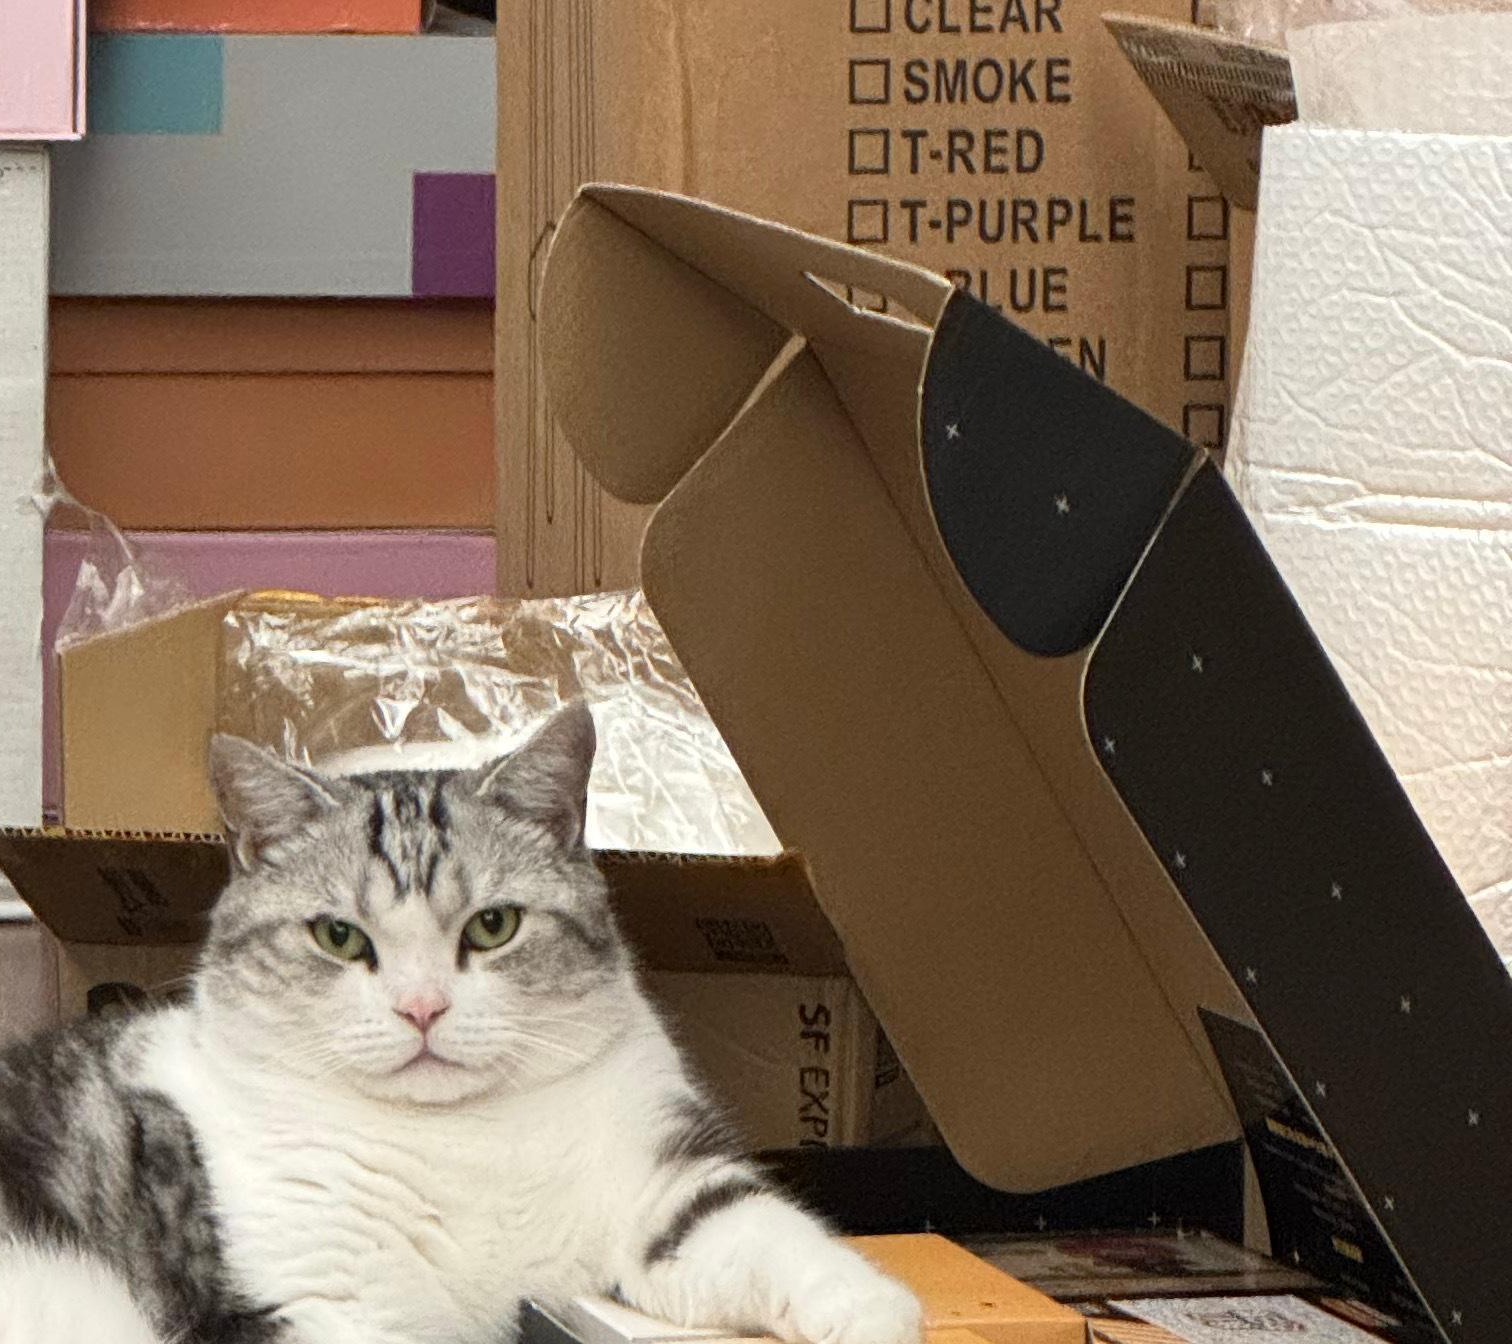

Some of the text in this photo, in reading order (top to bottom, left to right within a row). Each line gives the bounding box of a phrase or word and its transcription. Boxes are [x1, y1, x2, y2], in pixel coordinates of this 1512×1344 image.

[904, 57, 1072, 104] SMOKE
[900, 128, 1045, 175] T-RED
[900, 197, 1135, 244] T-PURPLE
[799, 1004, 831, 1053] SF
